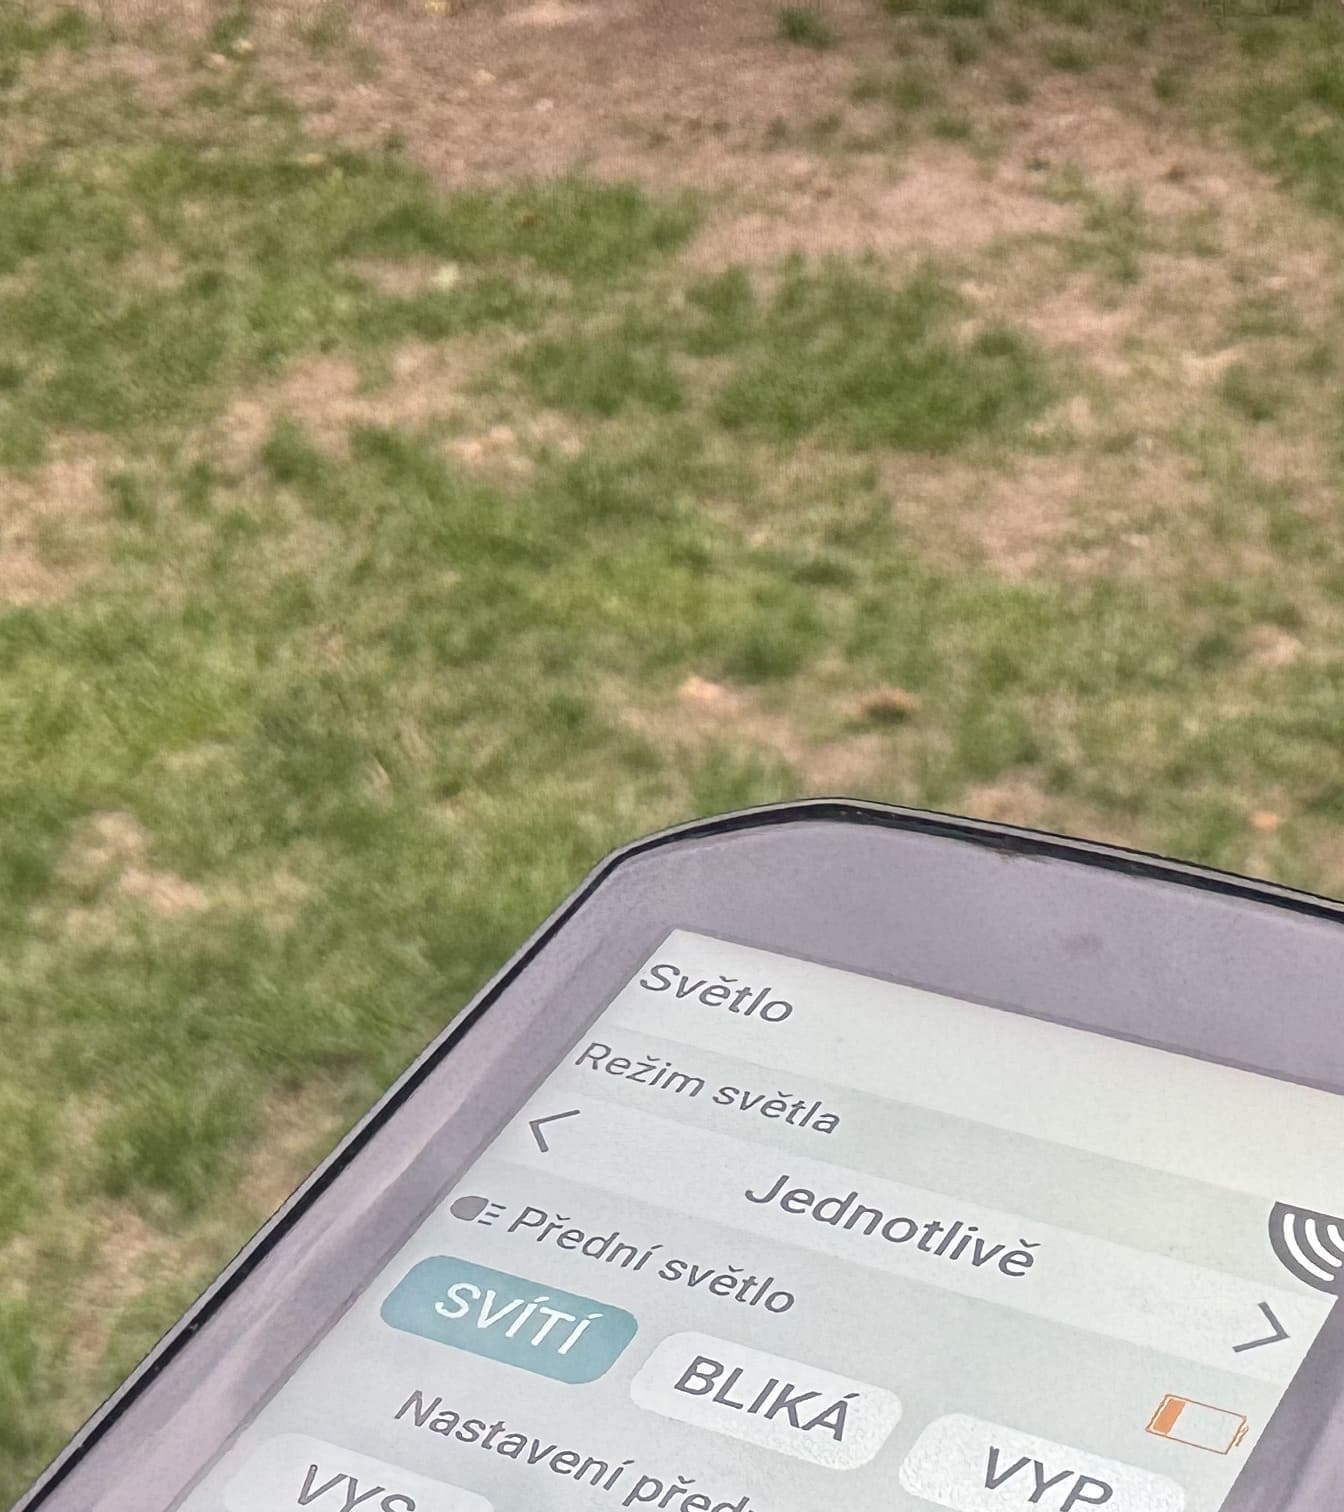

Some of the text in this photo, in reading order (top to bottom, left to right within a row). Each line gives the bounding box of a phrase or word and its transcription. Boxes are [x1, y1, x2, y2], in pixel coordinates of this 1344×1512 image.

[638, 962, 794, 1024] Světlo
[573, 1041, 841, 1136] Režim světla
[506, 1206, 796, 1315] Přední světlo
[744, 1174, 1042, 1278] Jednotlivě
[434, 1281, 602, 1356] SVÍTÍ
[394, 1390, 638, 1492] Nastavení
[673, 1355, 861, 1443] BLIKÁ
